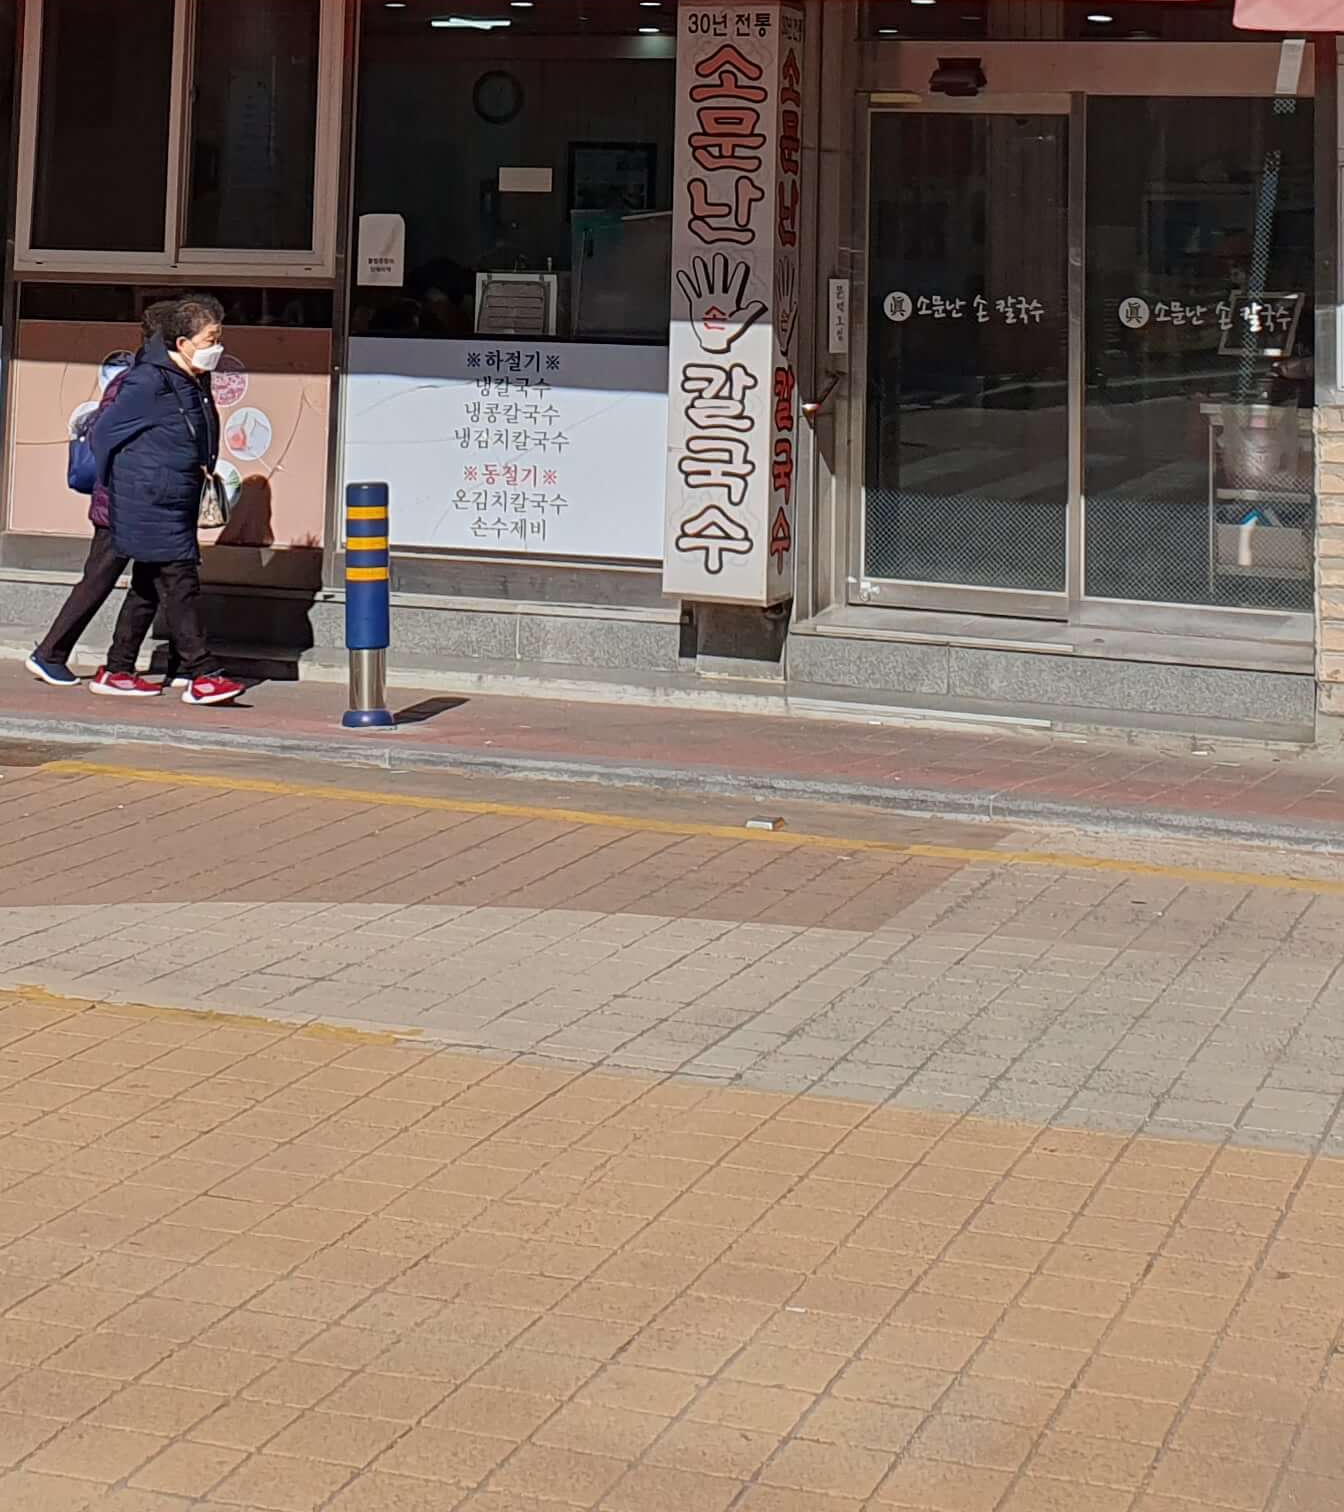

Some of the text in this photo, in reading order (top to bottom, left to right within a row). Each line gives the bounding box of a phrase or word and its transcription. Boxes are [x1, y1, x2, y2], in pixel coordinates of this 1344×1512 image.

[687, 12, 728, 37] 30년
[734, 12, 773, 39] 전통
[687, 43, 769, 246] 소문난
[778, 47, 801, 248] 소문난
[702, 305, 729, 331] 손
[917, 295, 964, 319] 소문난
[973, 295, 991, 322] 손
[995, 296, 1046, 325] 칼국수
[1155, 301, 1206, 326] 소문난
[1216, 303, 1233, 330] 손
[1239, 304, 1293, 333] 칼국수
[476, 376, 552, 400] 냉칼국수
[465, 402, 560, 426] 냉콩칼국수
[454, 427, 570, 453] 냉김치칼국수
[675, 362, 759, 575] 칼국수
[769, 364, 796, 576] 칼국수
[452, 489, 569, 515] 온김치칼국수
[470, 516, 547, 542] 손수제비
